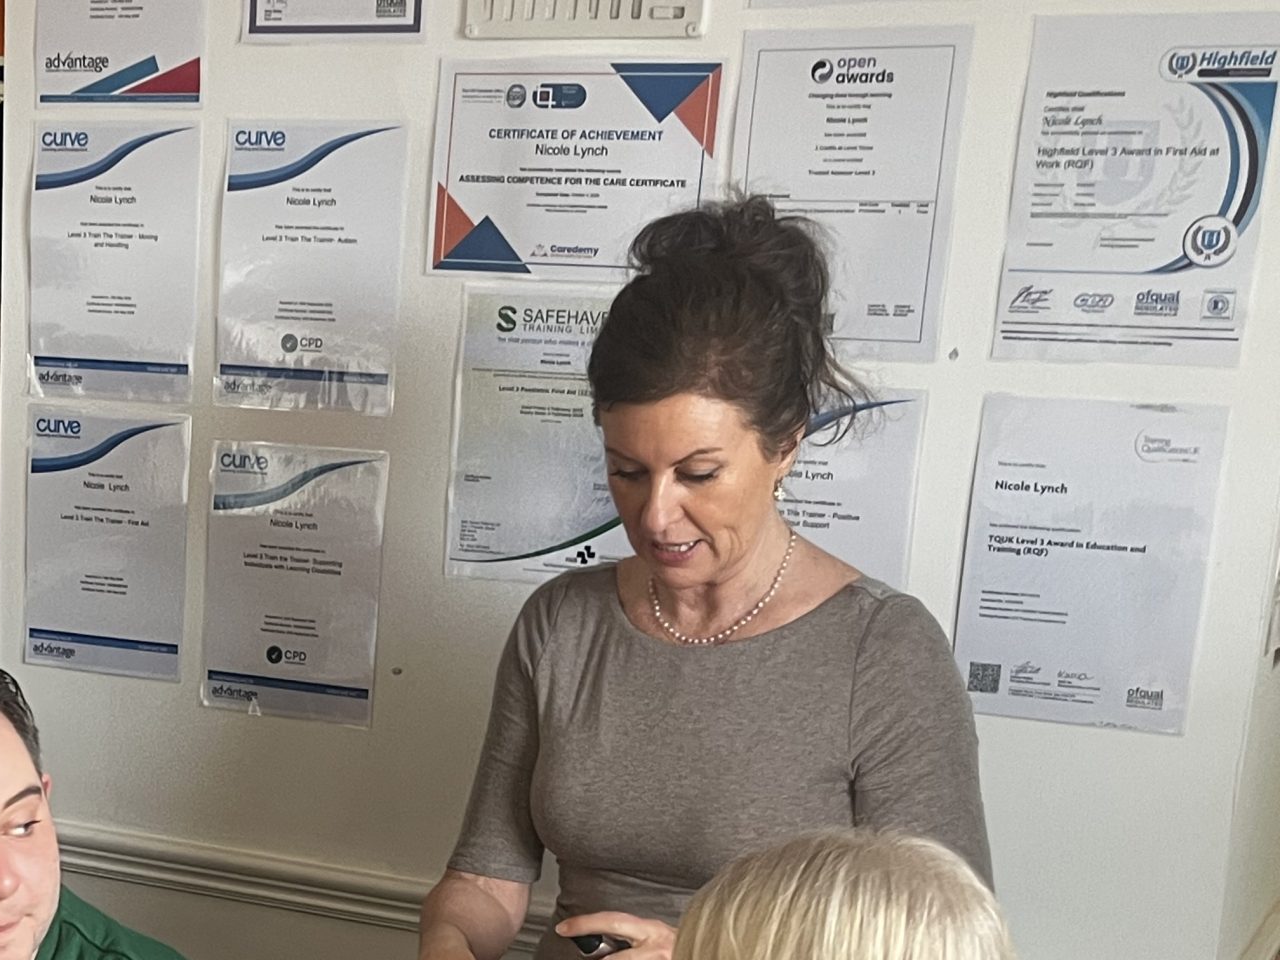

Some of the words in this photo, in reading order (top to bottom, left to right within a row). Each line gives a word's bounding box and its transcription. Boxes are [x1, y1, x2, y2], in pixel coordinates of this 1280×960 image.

[837, 57, 877, 73] open
[1199, 50, 1278, 68] Highfield
[835, 69, 894, 84] awards
[42, 131, 88, 147] curve
[235, 130, 285, 147] curve
[489, 129, 558, 140] CERTIFICATE
[561, 130, 575, 140] OF
[579, 130, 663, 141] ACHIEVEMENT
[535, 144, 570, 156] Nicole
[574, 144, 608, 158] Lynch
[1037, 147, 1079, 157] Highfield
[1082, 147, 1108, 156] Level
[1120, 148, 1152, 156] Award
[1154, 148, 1162, 156] in
[1166, 148, 1187, 156] First
[1192, 147, 1207, 156] Aid
[1036, 159, 1061, 168] Work
[1064, 160, 1094, 170] (RQF)
[459, 174, 505, 183] ASSESSING
[506, 176, 562, 185] COMPETENCE
[564, 176, 582, 185] FOR
[585, 178, 601, 186] THE
[603, 178, 626, 187] CARE
[629, 179, 687, 188] CERTIFICATE
[114, 195, 136, 205] Lynch
[313, 197, 336, 207] Lynch
[1136, 289, 1181, 304] ofqual
[522, 324, 572, 334] TRAINING
[300, 338, 323, 348] CPD
[36, 419, 81, 434] curve
[220, 453, 268, 470] curve
[805, 470, 833, 481] Lynch
[995, 481, 1030, 492] Nicole
[1034, 482, 1068, 495] Lynch
[988, 535, 1014, 545] TQUK
[1016, 537, 1038, 545] Level
[1047, 539, 1075, 548] Award
[1085, 542, 1128, 552] Education
[1130, 545, 1146, 553] and
[284, 650, 307, 662] CPD
[1127, 687, 1163, 700] ofqual
